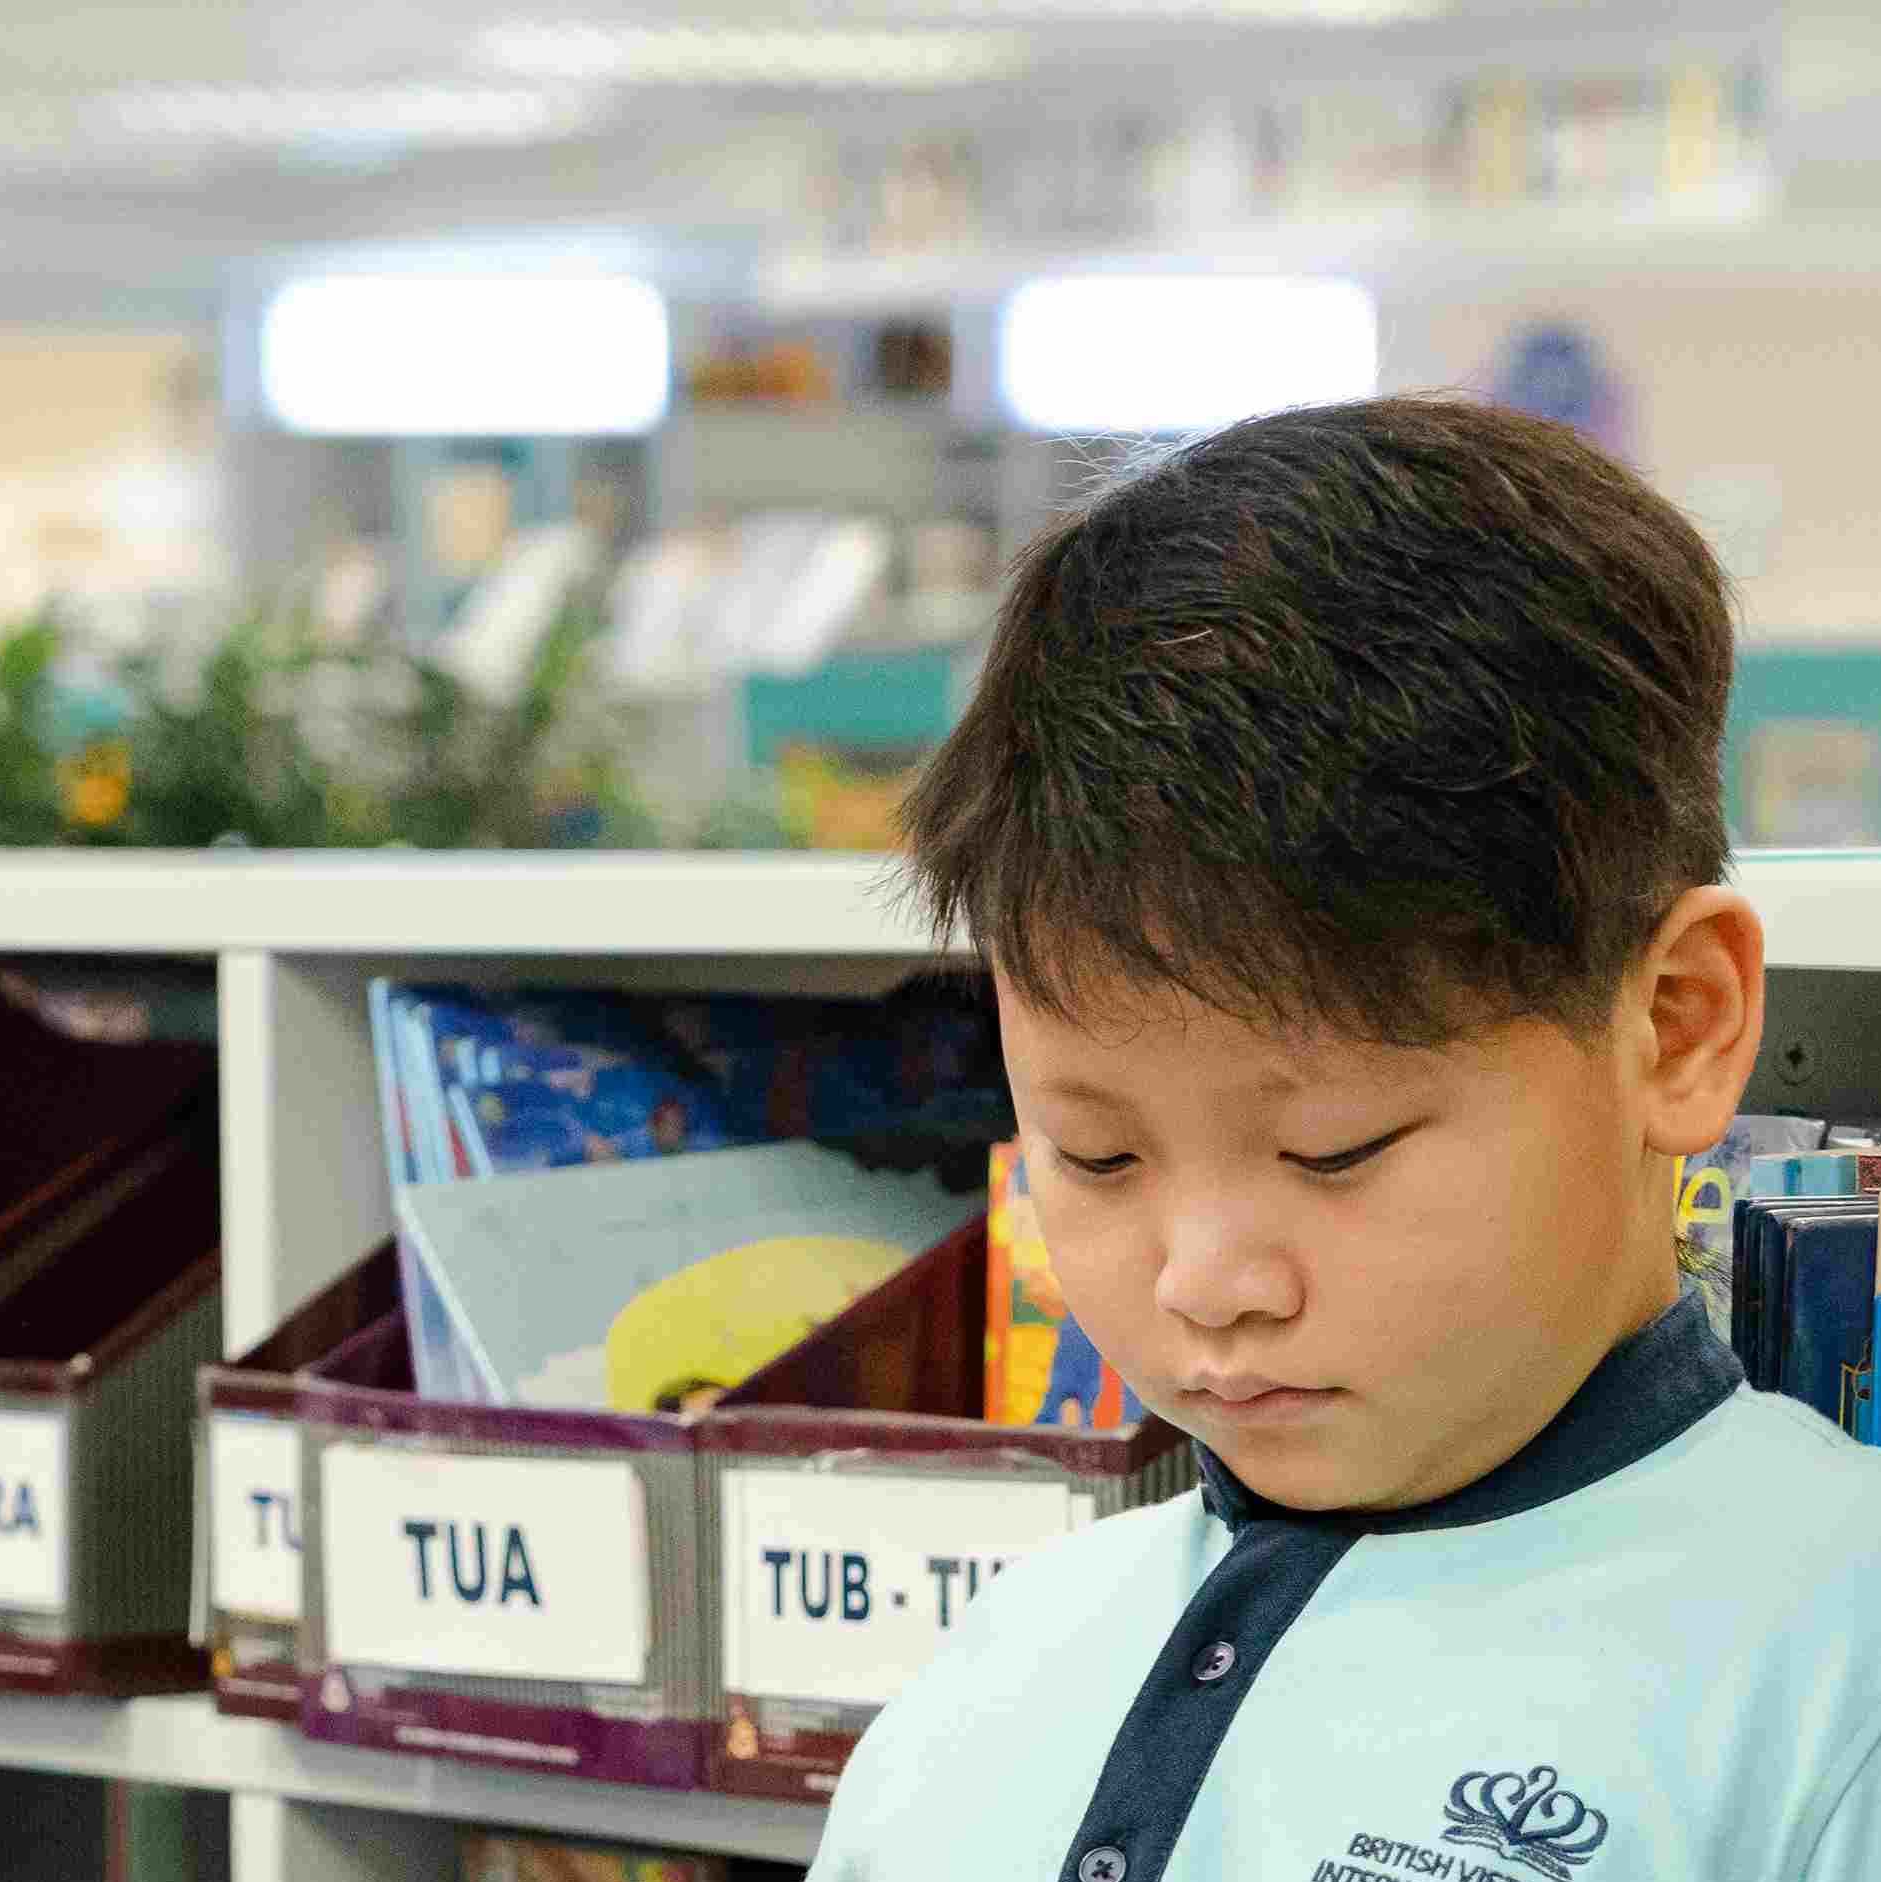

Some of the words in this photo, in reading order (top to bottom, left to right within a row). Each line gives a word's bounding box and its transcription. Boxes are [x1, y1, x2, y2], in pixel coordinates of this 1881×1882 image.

[404, 1521, 540, 1606] TUA
[763, 1550, 871, 1622] TUB
[1348, 1832, 1454, 1879] BRITISH
